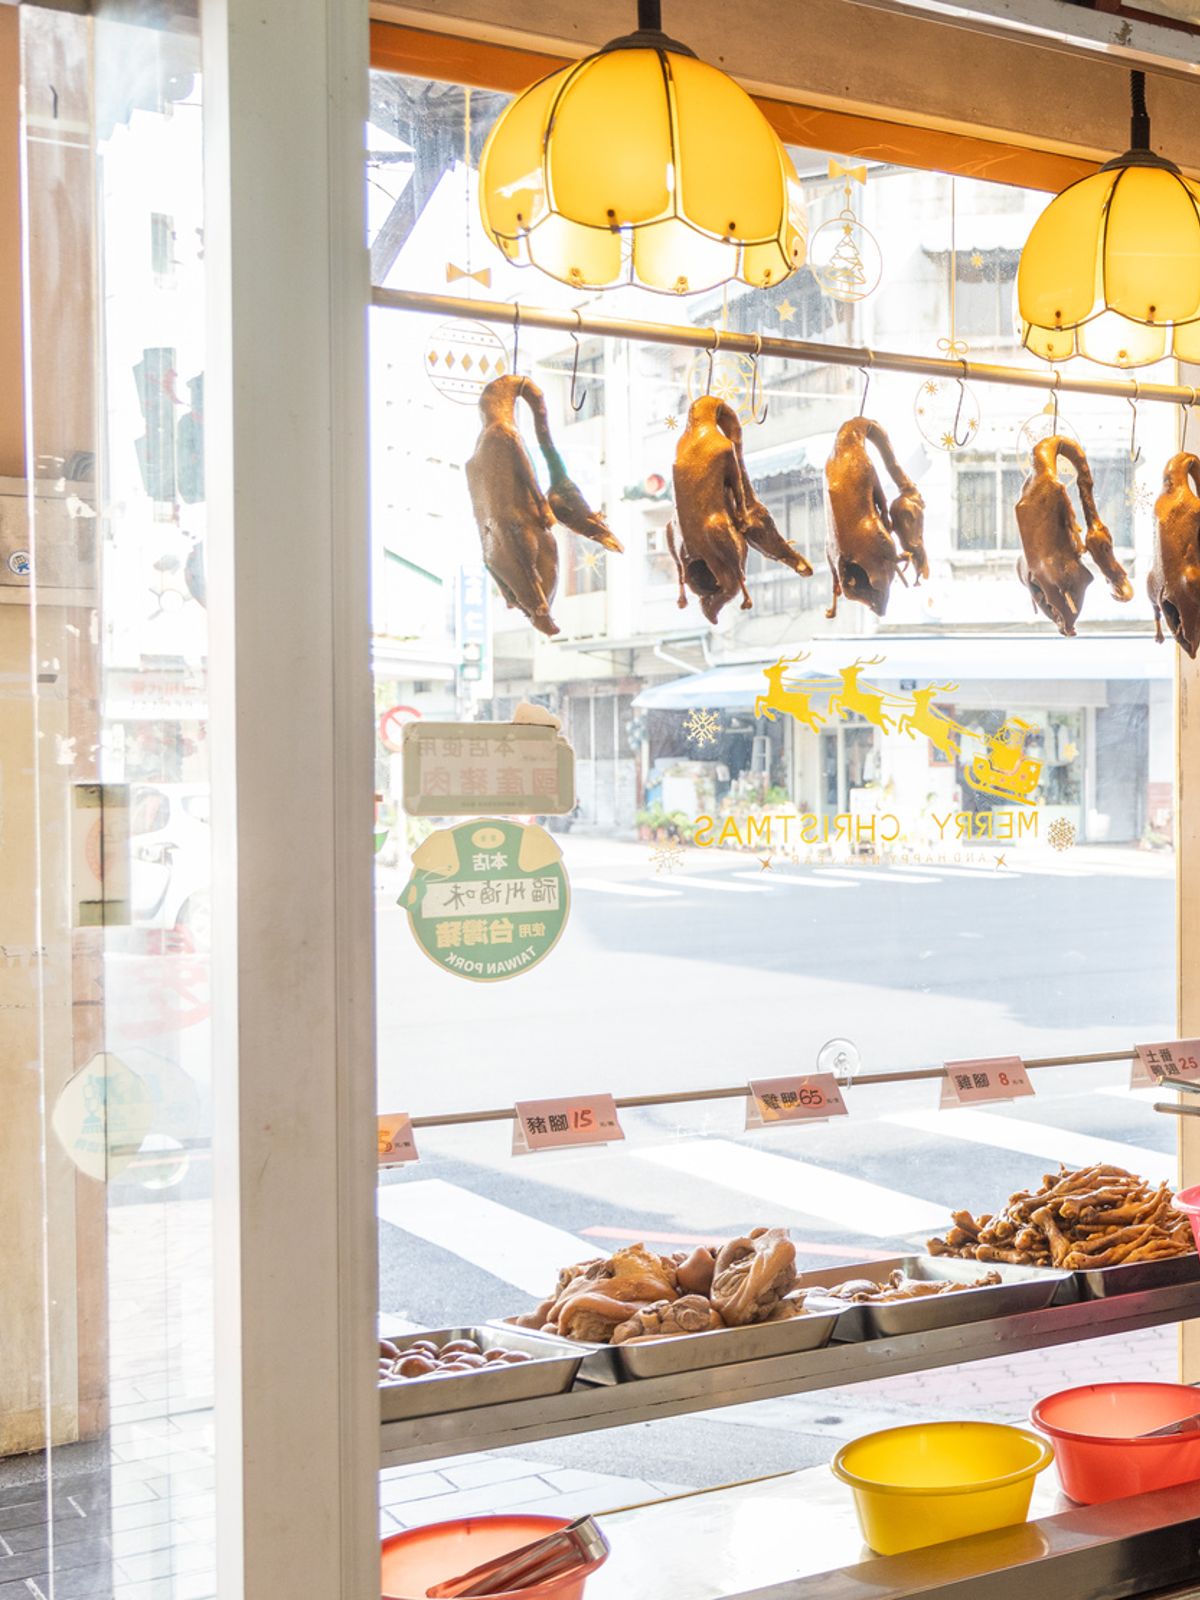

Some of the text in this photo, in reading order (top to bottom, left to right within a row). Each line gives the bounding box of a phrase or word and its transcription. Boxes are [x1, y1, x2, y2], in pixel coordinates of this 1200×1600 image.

[1178, 1056, 1199, 1070] 25
[998, 1073, 1009, 1086] 8
[799, 1089, 823, 1106] 65
[526, 1109, 593, 1135] 豬腳 15
